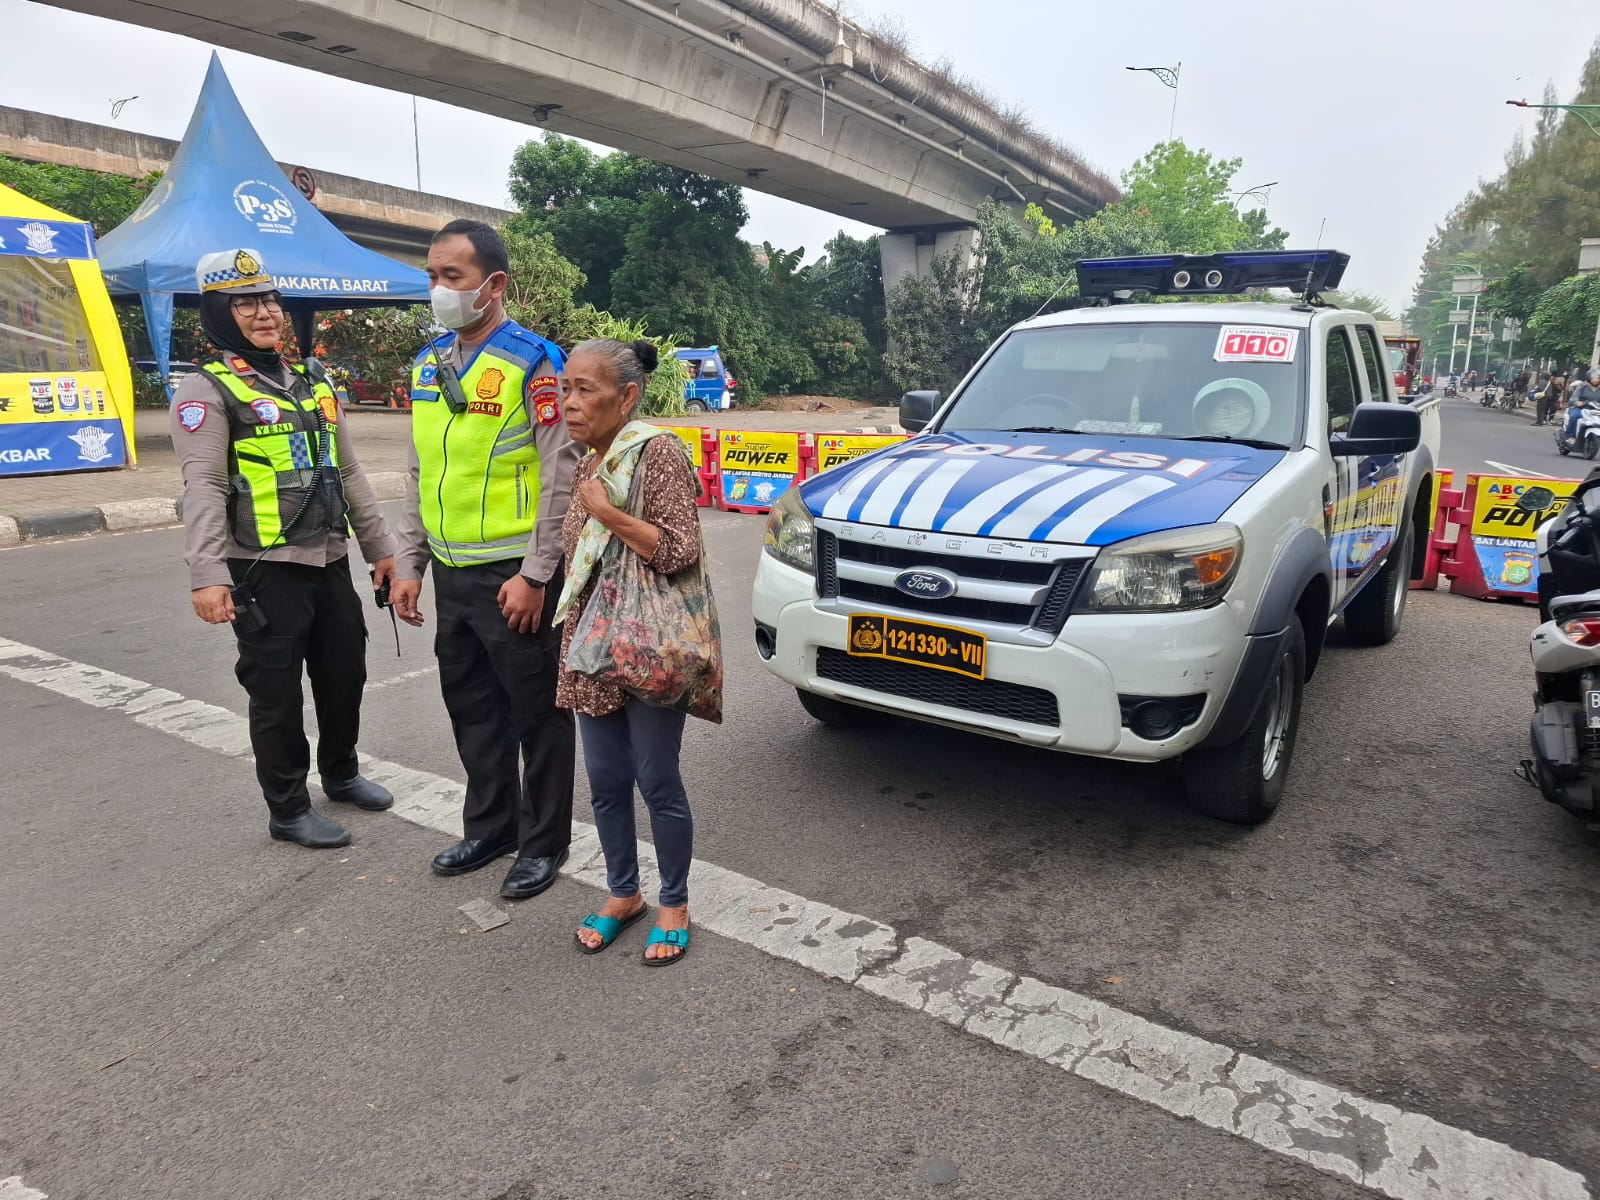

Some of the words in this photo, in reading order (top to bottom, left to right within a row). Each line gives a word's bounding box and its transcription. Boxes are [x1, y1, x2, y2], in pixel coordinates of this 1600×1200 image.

[238, 194, 292, 222] P3S
[342, 278, 389, 292] BARAT
[1227, 336, 1286, 355] 110
[57, 381, 76, 389] ABC
[530, 377, 556, 389] POLDA
[32, 386, 50, 394] ABC
[469, 402, 500, 413] POLRI
[258, 423, 291, 434] YENI
[724, 434, 743, 442] ABC
[823, 439, 844, 448] ABC
[724, 449, 790, 467] POWER
[895, 443, 1208, 478] POLISI
[1487, 483, 1525, 496] ABC
[840, 525, 1050, 558] RANGER
[1475, 537, 1495, 546] SAT
[1495, 538, 1537, 549] LANTAS
[906, 573, 940, 593] Ford
